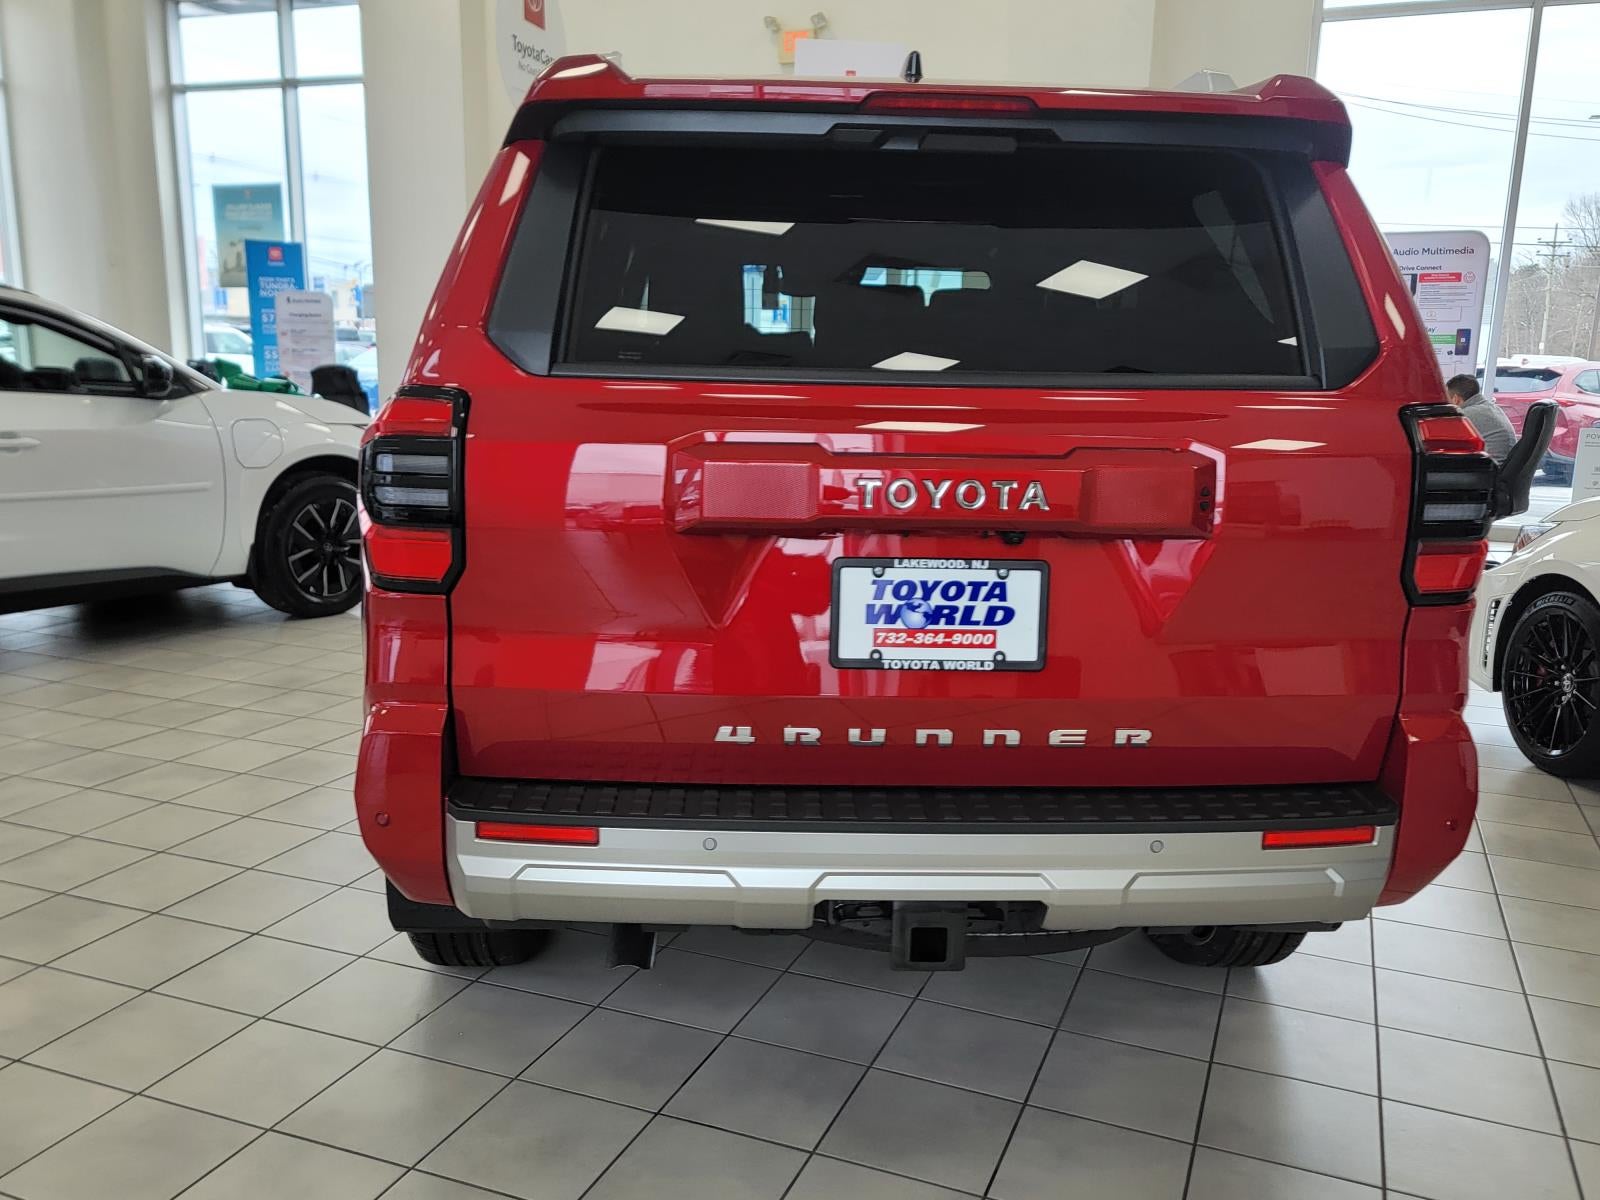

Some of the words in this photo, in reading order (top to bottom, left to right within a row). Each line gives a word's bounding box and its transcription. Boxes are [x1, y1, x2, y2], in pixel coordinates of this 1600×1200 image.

[512, 33, 554, 65] ToyotaCar
[1393, 248, 1419, 256] Audio
[1422, 246, 1475, 256] Multimedia
[857, 478, 1050, 511] TOYOTA
[971, 559, 990, 570] NJ
[871, 579, 1008, 602] TOYOTA
[865, 599, 1016, 629] WORLD
[875, 632, 995, 646] 732-364-9000
[881, 660, 941, 670] TOYOTA
[942, 661, 995, 671] WORLD
[714, 725, 1153, 748] 4RUNNER
